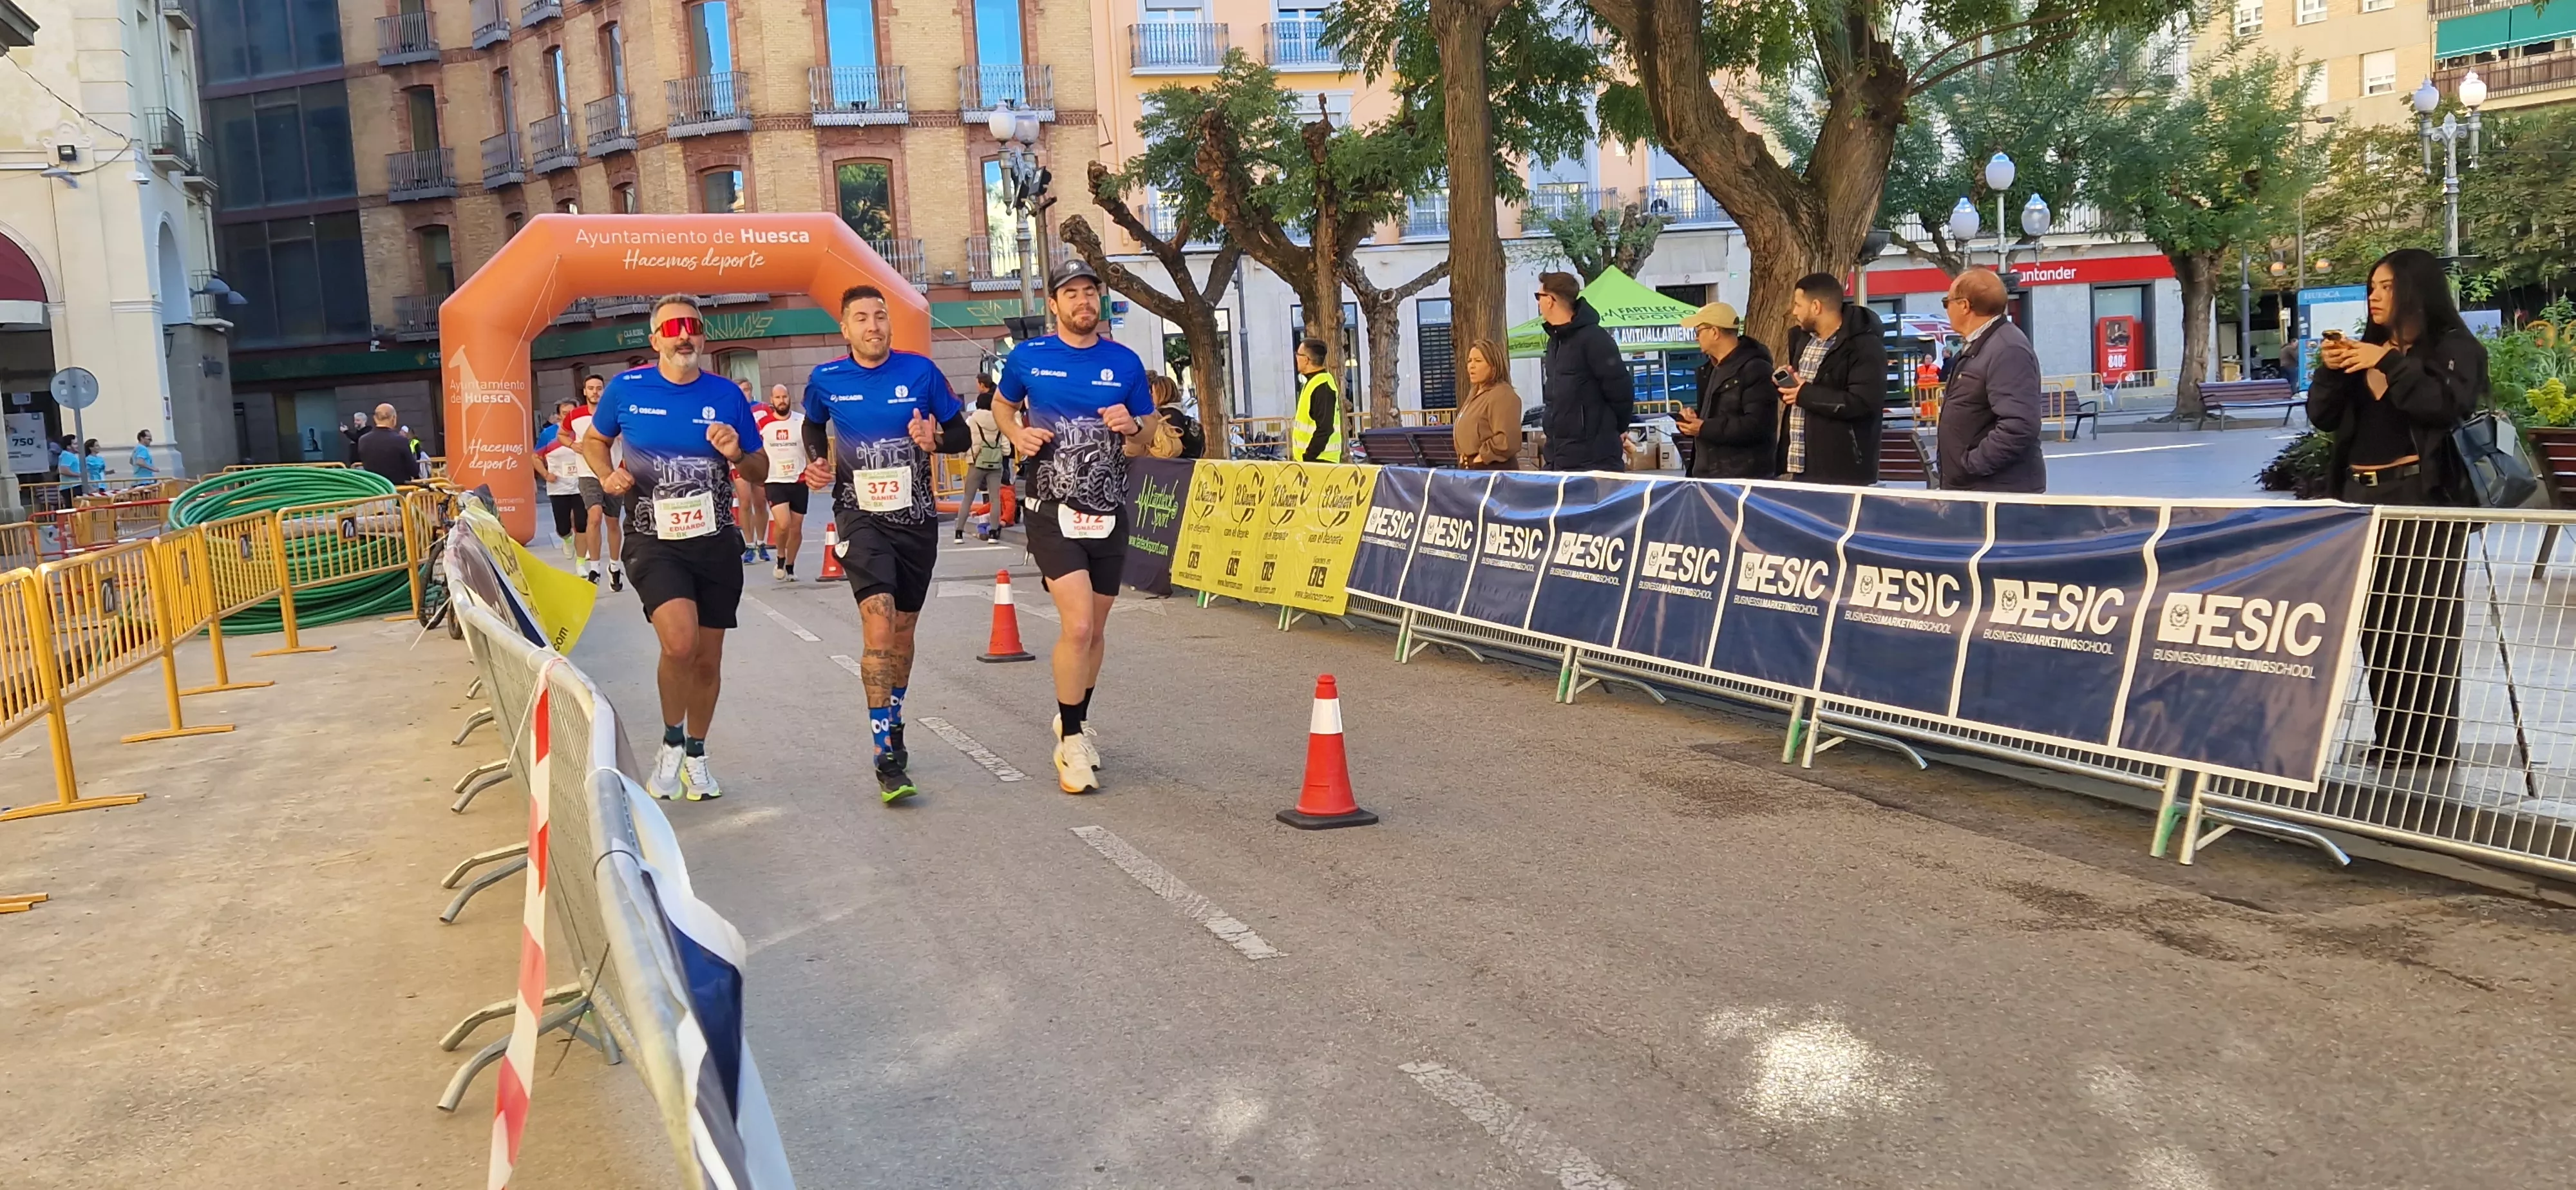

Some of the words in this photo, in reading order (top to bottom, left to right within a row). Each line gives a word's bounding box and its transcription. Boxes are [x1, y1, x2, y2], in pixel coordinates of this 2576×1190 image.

[576, 229, 707, 248] Ayuntamiento
[713, 229, 735, 244] de
[741, 229, 810, 243] Huesca
[622, 249, 699, 270] Hacemos
[701, 247, 765, 276] deporte
[2304, 291, 2340, 299] HUESCA
[450, 379, 525, 393] Ayuntamiento
[451, 393, 460, 404] de
[465, 392, 511, 404] Huesca
[12, 438, 33, 446] 750
[466, 438, 524, 455] Hacemos
[469, 453, 518, 476] deporte
[867, 480, 900, 494] 373
[670, 509, 703, 525] 374
[670, 522, 706, 532] EDUARDO
[1073, 510, 1104, 524] 372
[1376, 507, 1414, 540] ESIC
[1434, 516, 1473, 550] ESIC
[1498, 525, 1543, 560] ESIC
[1569, 533, 1625, 572] ESIC
[1658, 543, 1720, 585] ESIC
[1758, 554, 1829, 600] ESIC
[1877, 567, 1960, 618] ESIC
[2020, 581, 2125, 635] ESIC
[2197, 594, 2326, 657] ESIC
[1983, 628, 2114, 655] BUSINESS&MARKETINGSCHOOL
[2152, 648, 2316, 679] BUSINESS&MARKETINGSCHOOL
